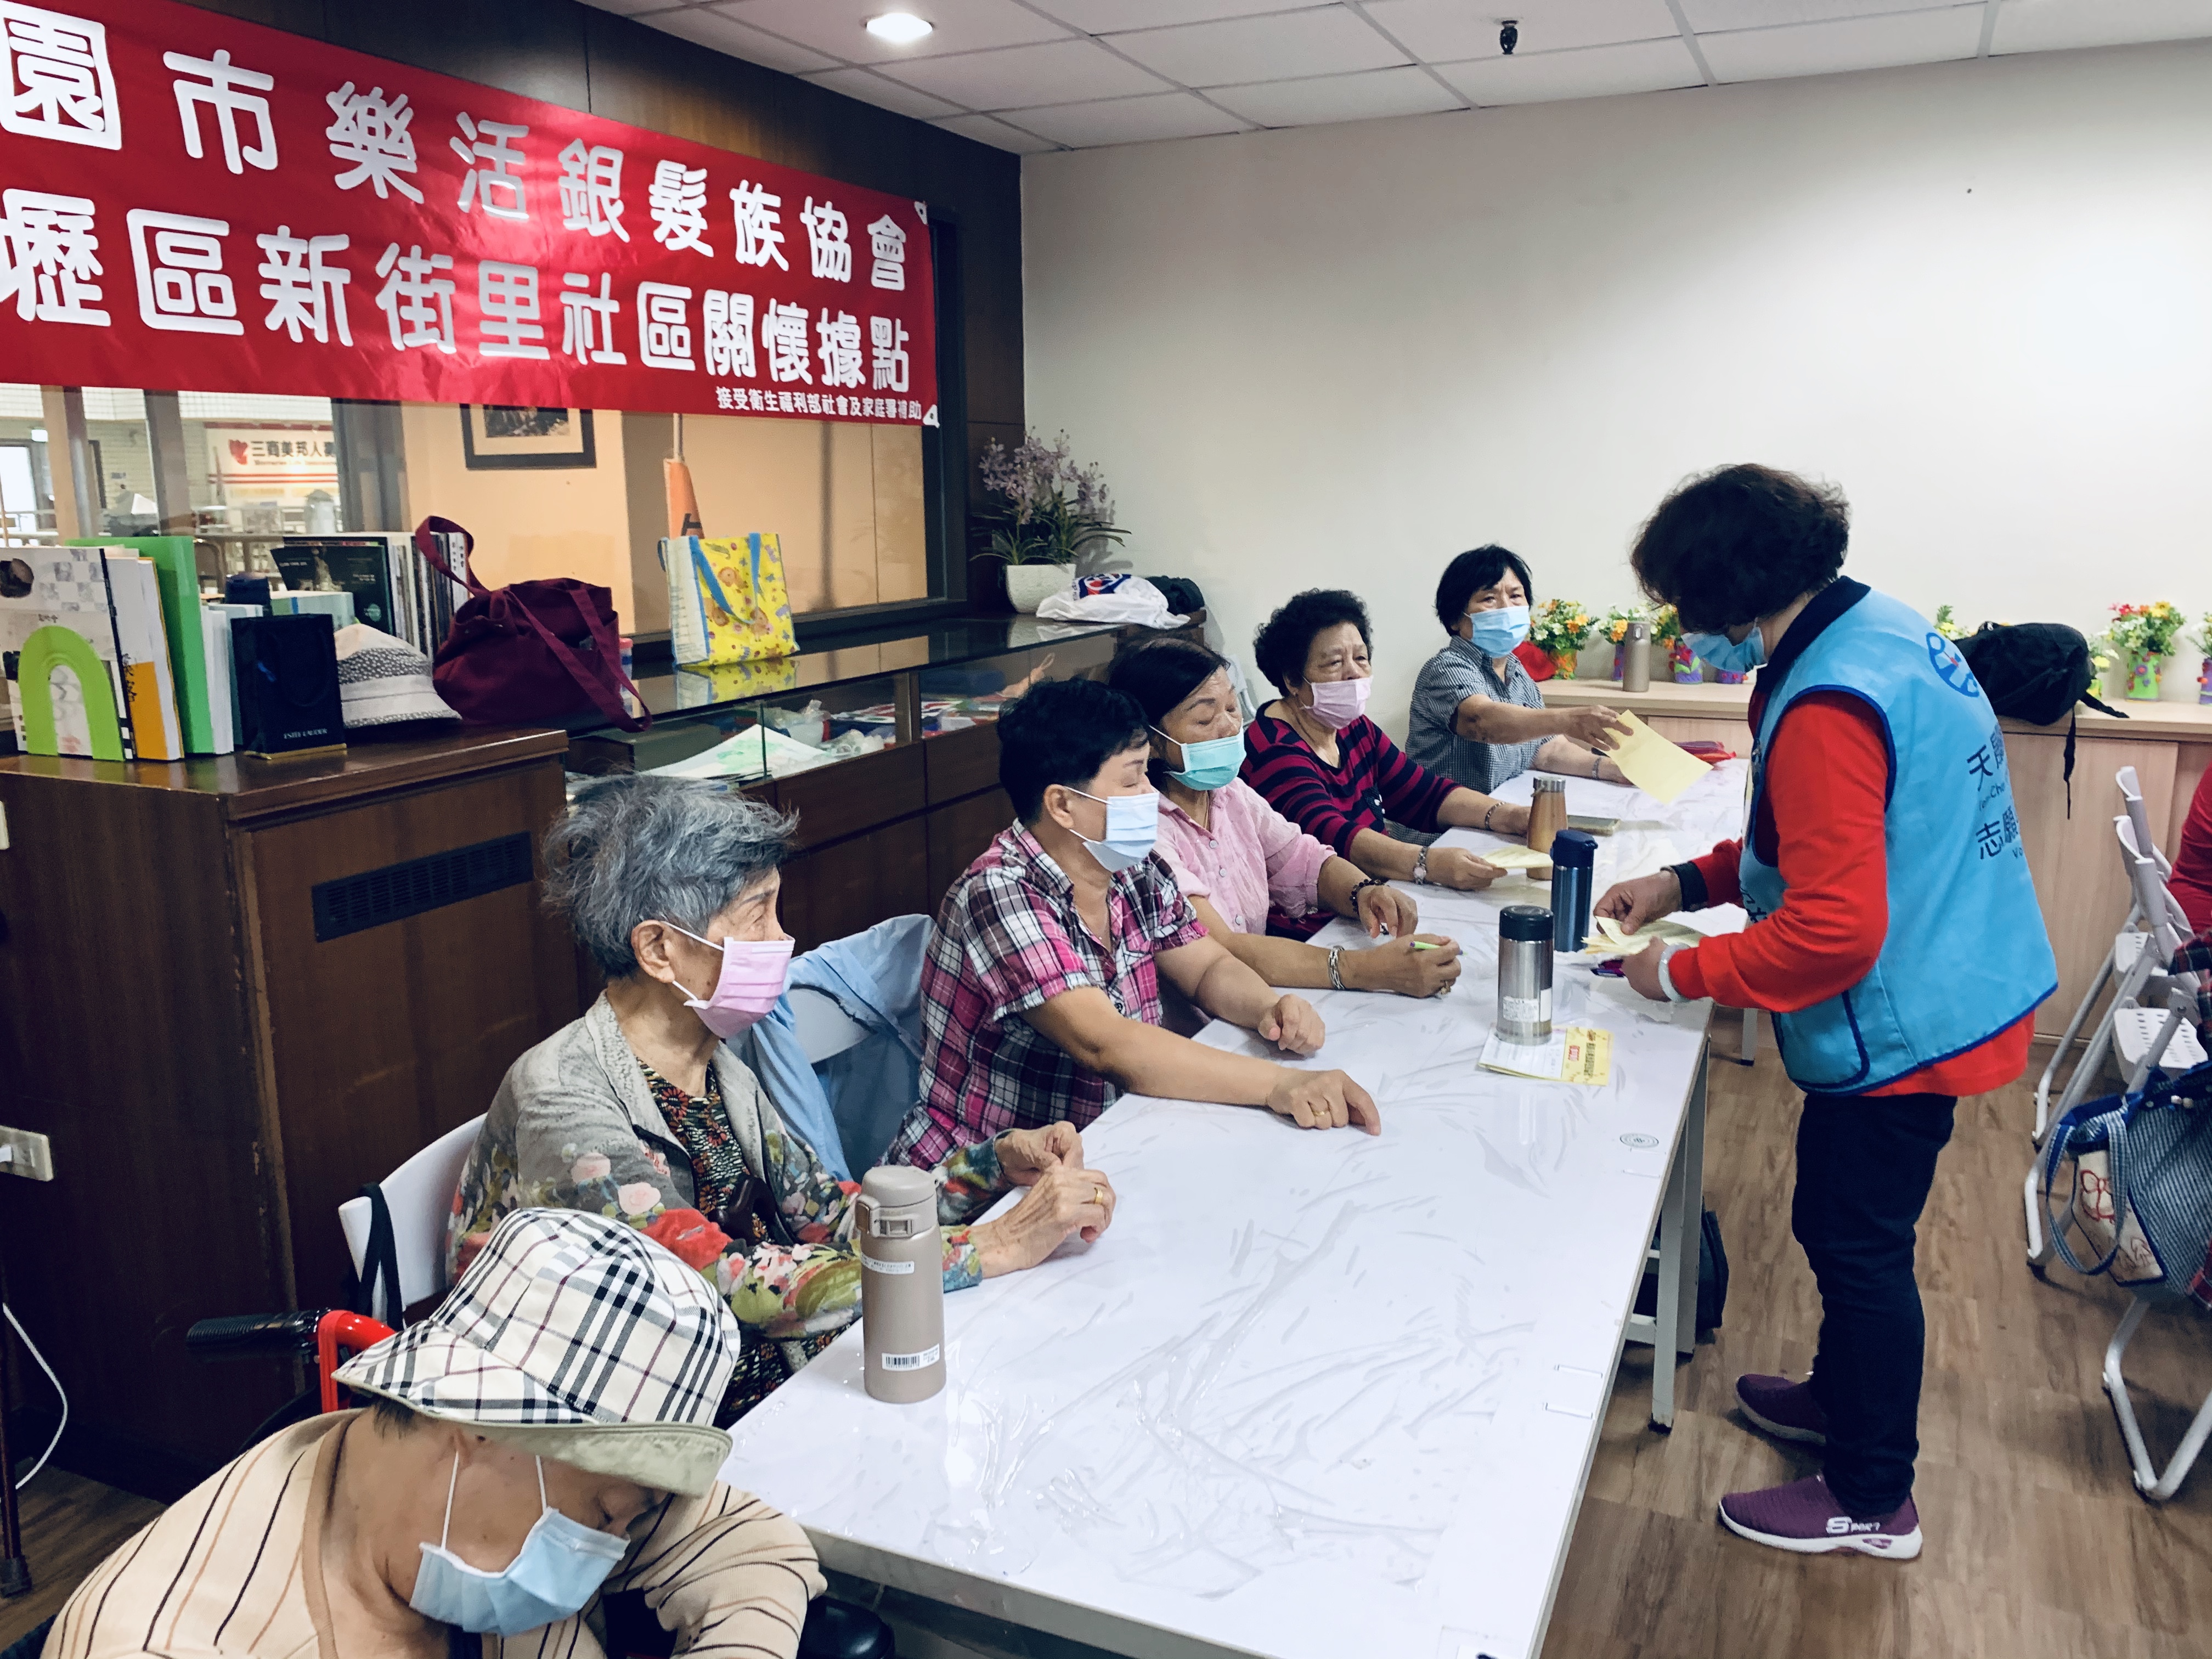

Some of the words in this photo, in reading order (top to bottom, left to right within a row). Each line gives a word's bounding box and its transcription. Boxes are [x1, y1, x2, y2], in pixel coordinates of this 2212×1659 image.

[0, 1, 906, 291] 園市樂活銀髮族協會
[0, 188, 909, 392] 壢區新街里社區關懷據點
[1976, 805, 2019, 859] 志願
